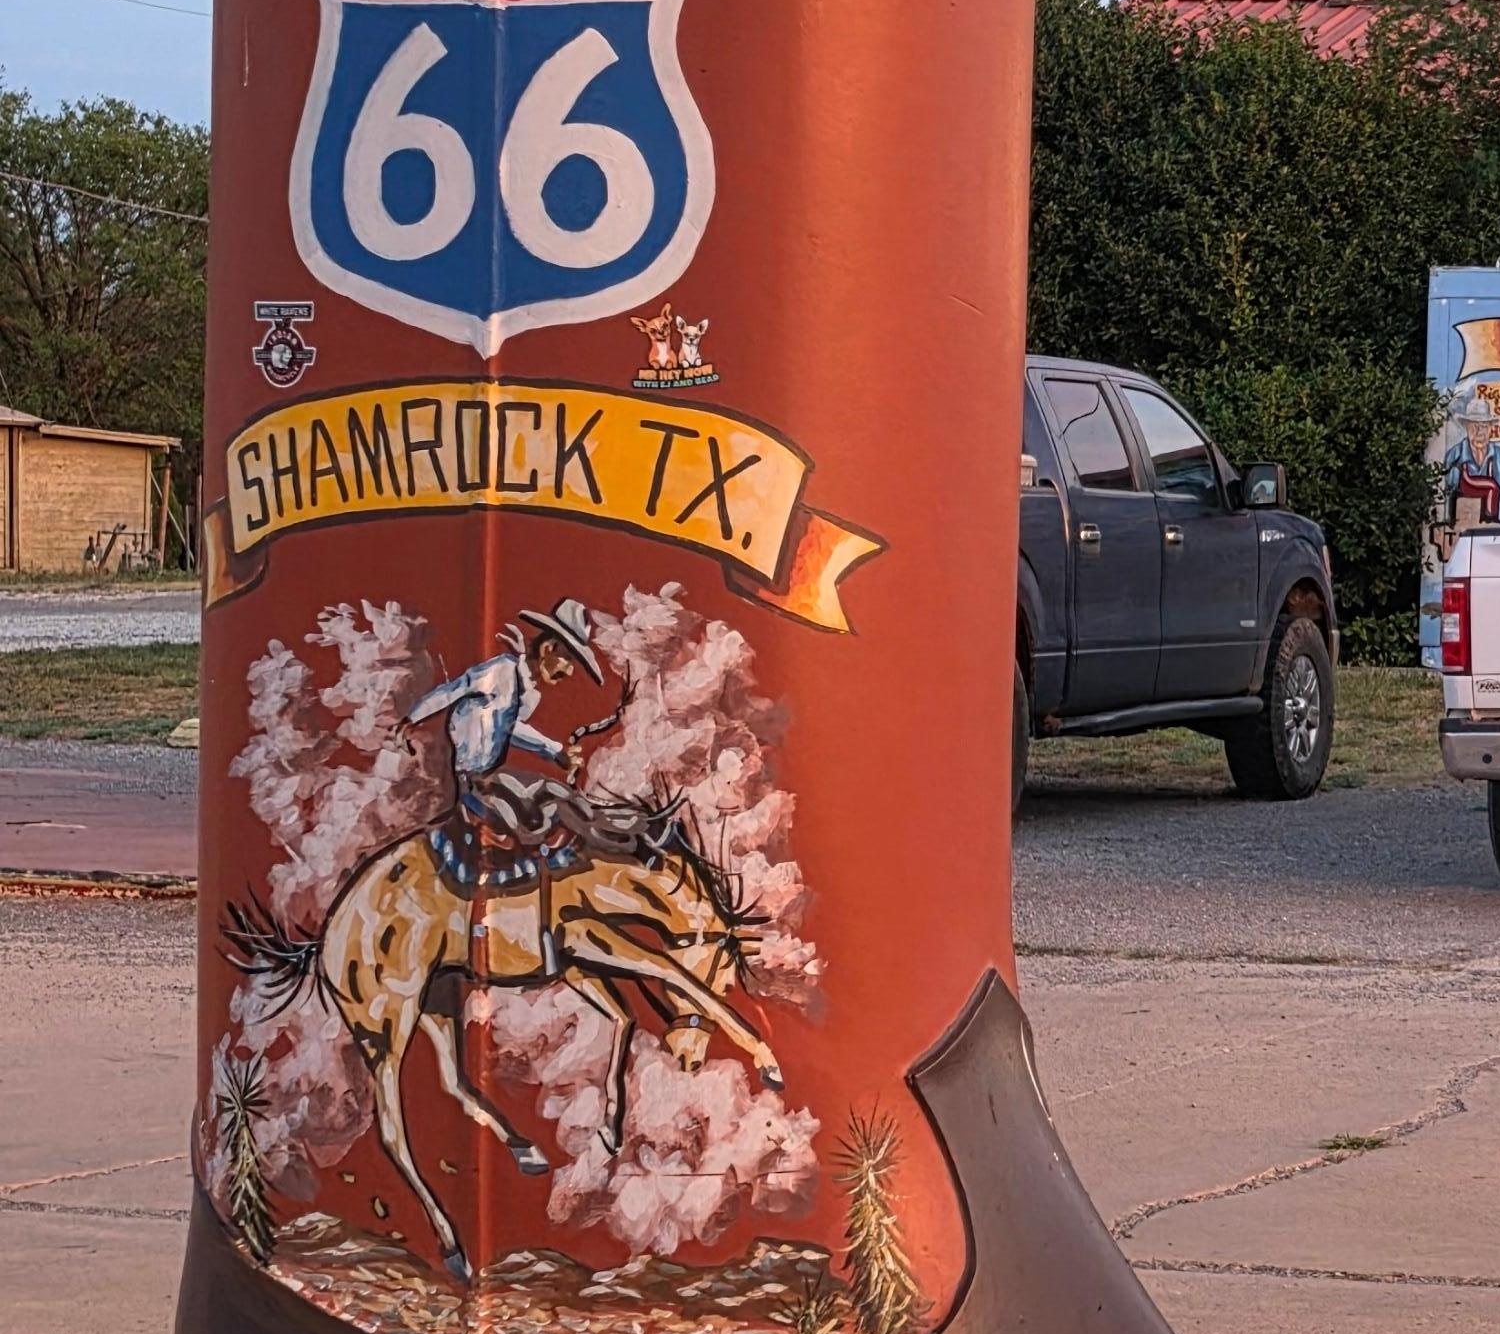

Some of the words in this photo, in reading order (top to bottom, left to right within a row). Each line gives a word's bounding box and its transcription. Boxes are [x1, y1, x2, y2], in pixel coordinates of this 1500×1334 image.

[343, 23, 654, 269] 66
[239, 399, 603, 527] SHAMROCK
[640, 419, 763, 551] TX.
